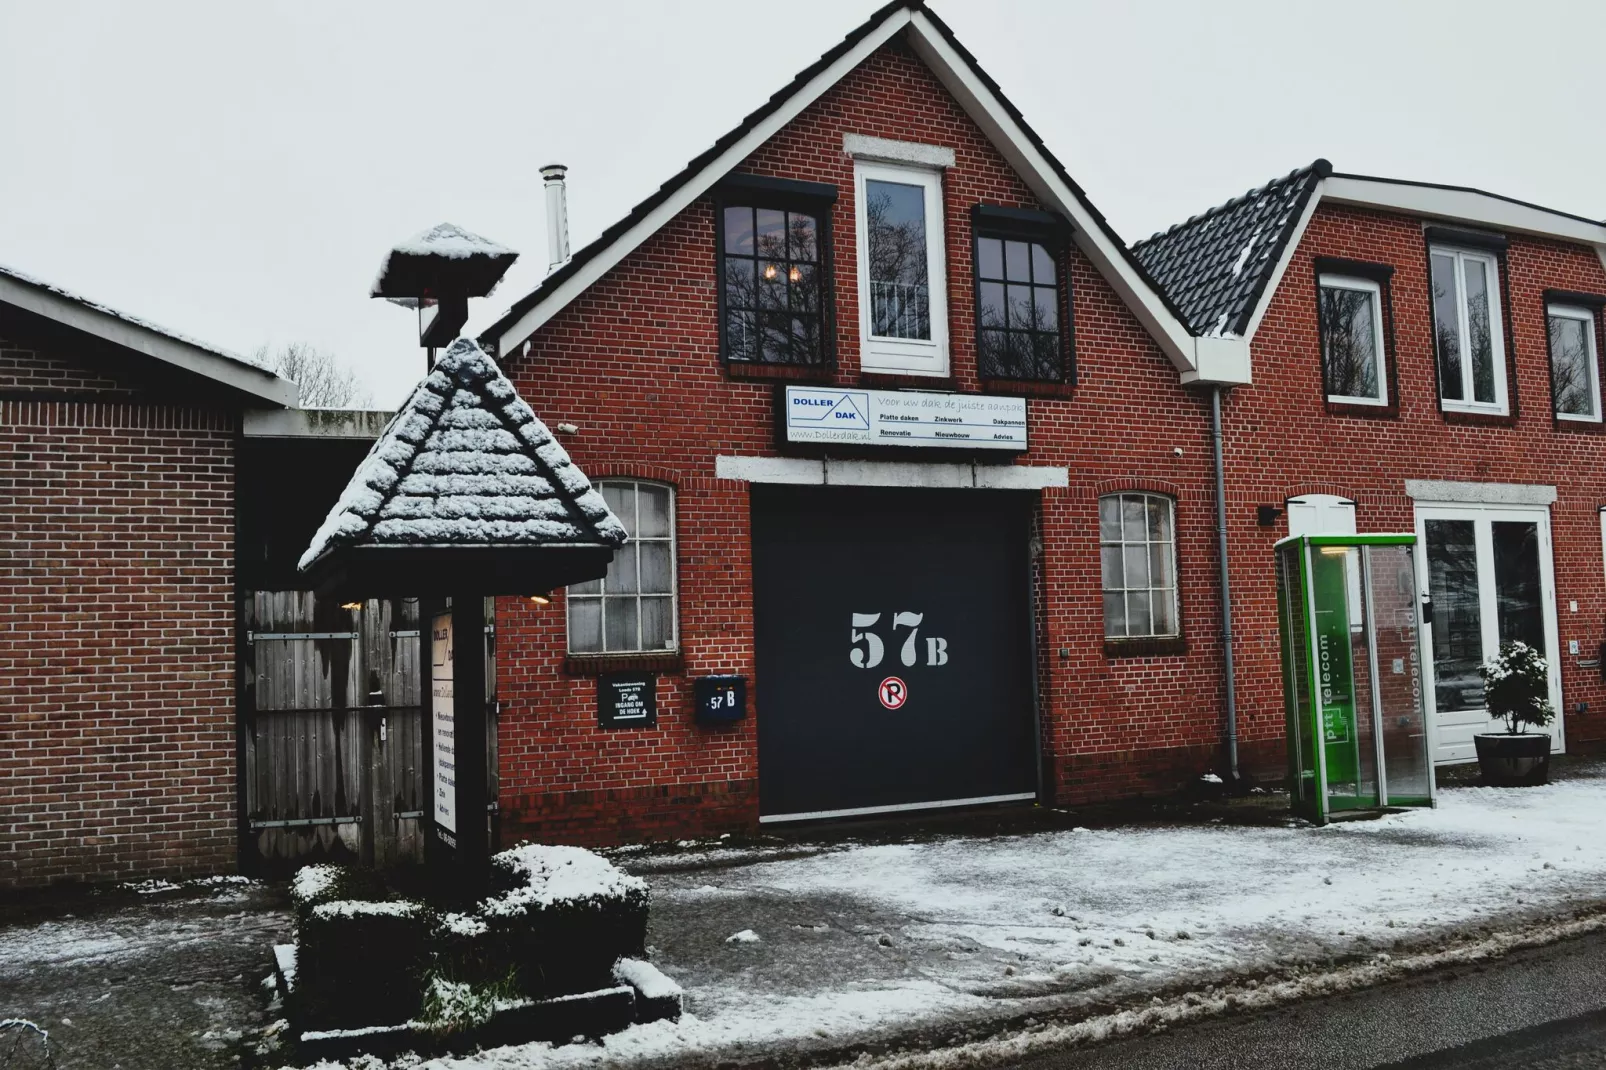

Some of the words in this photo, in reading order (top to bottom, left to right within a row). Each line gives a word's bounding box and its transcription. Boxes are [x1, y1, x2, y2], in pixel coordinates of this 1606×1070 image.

[793, 398, 834, 407] DOLLER
[878, 397, 900, 406] Voor
[903, 399, 919, 407] uw
[921, 399, 941, 408] dak
[944, 399, 956, 409] de
[957, 399, 985, 412] juiste
[992, 419, 1025, 427] Dakpannen
[790, 430, 871, 441] www.Dollerdak.nl
[1320, 634, 1333, 706] telecom
[1409, 645, 1421, 713] telecom
[1324, 713, 1337, 740] ptt
